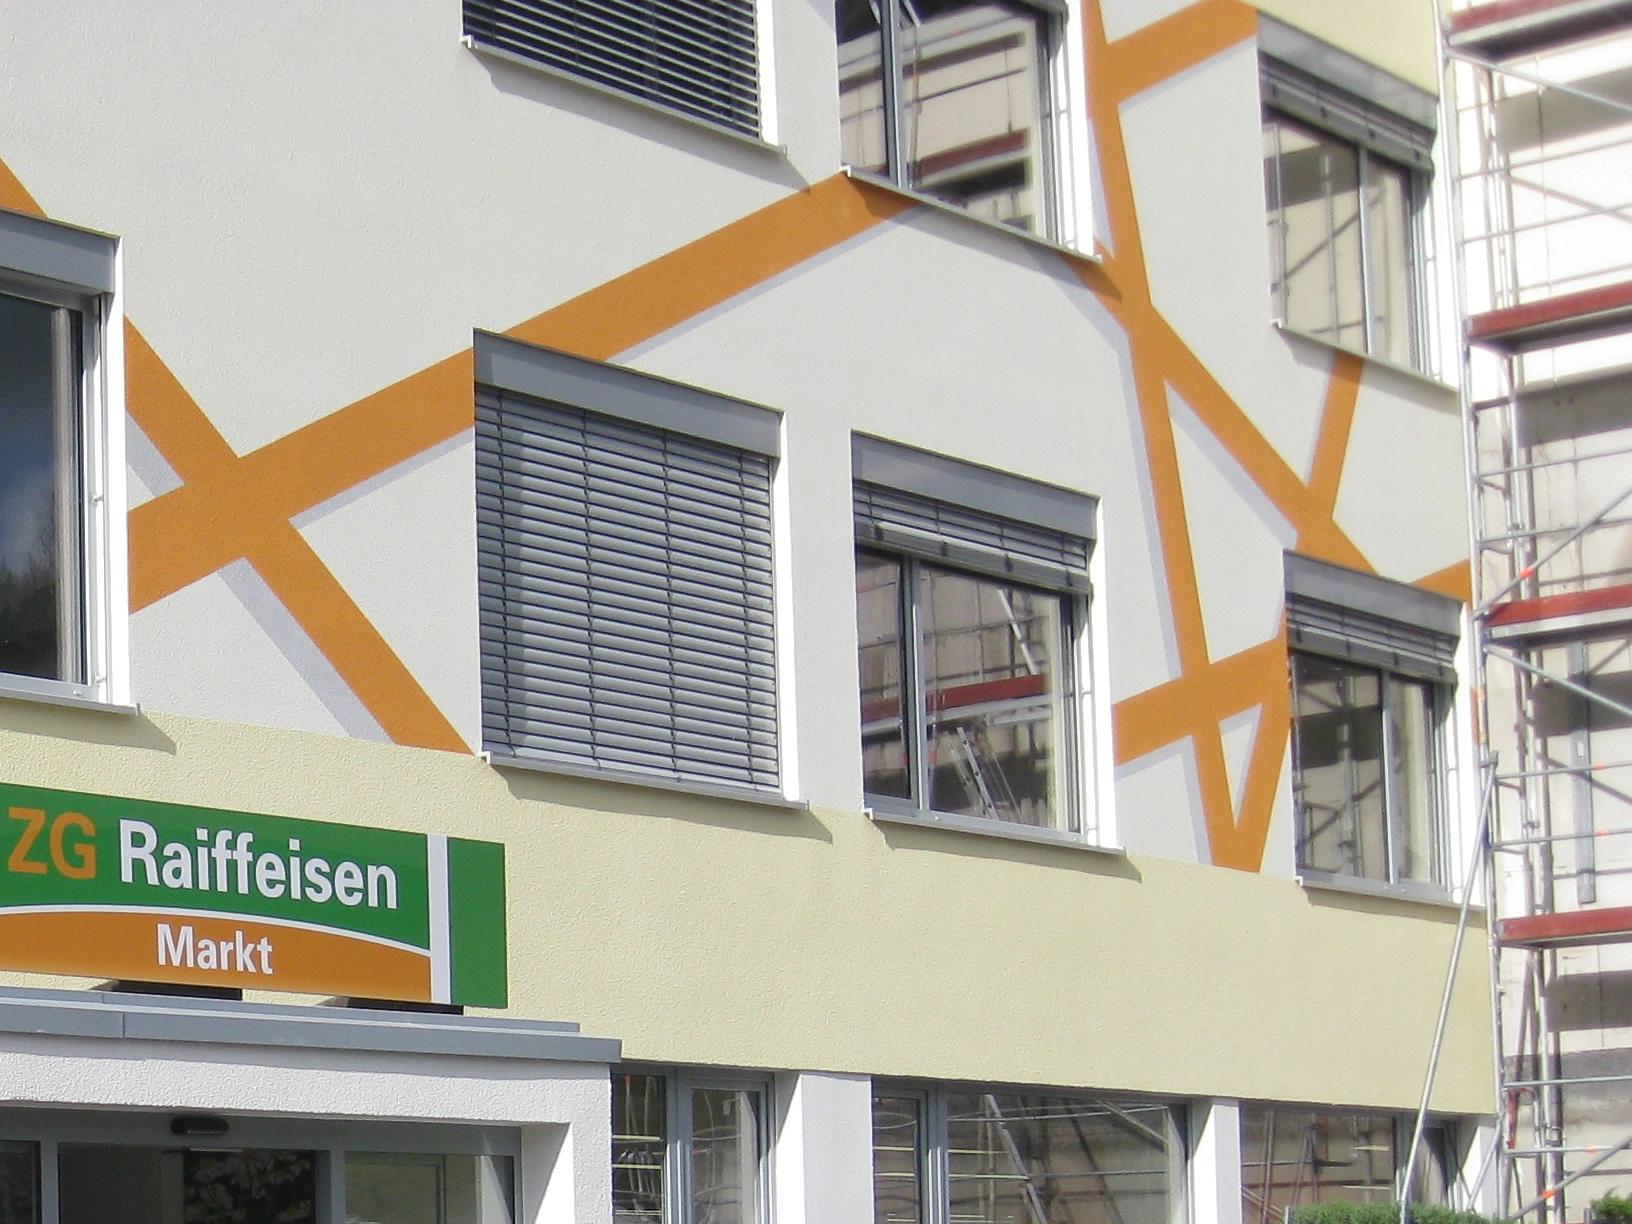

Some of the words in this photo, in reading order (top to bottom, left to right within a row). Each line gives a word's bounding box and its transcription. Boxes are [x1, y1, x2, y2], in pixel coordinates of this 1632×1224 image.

[6, 806, 97, 879] ZG
[118, 818, 397, 910] Raiffeisen
[156, 923, 273, 975] Markt
